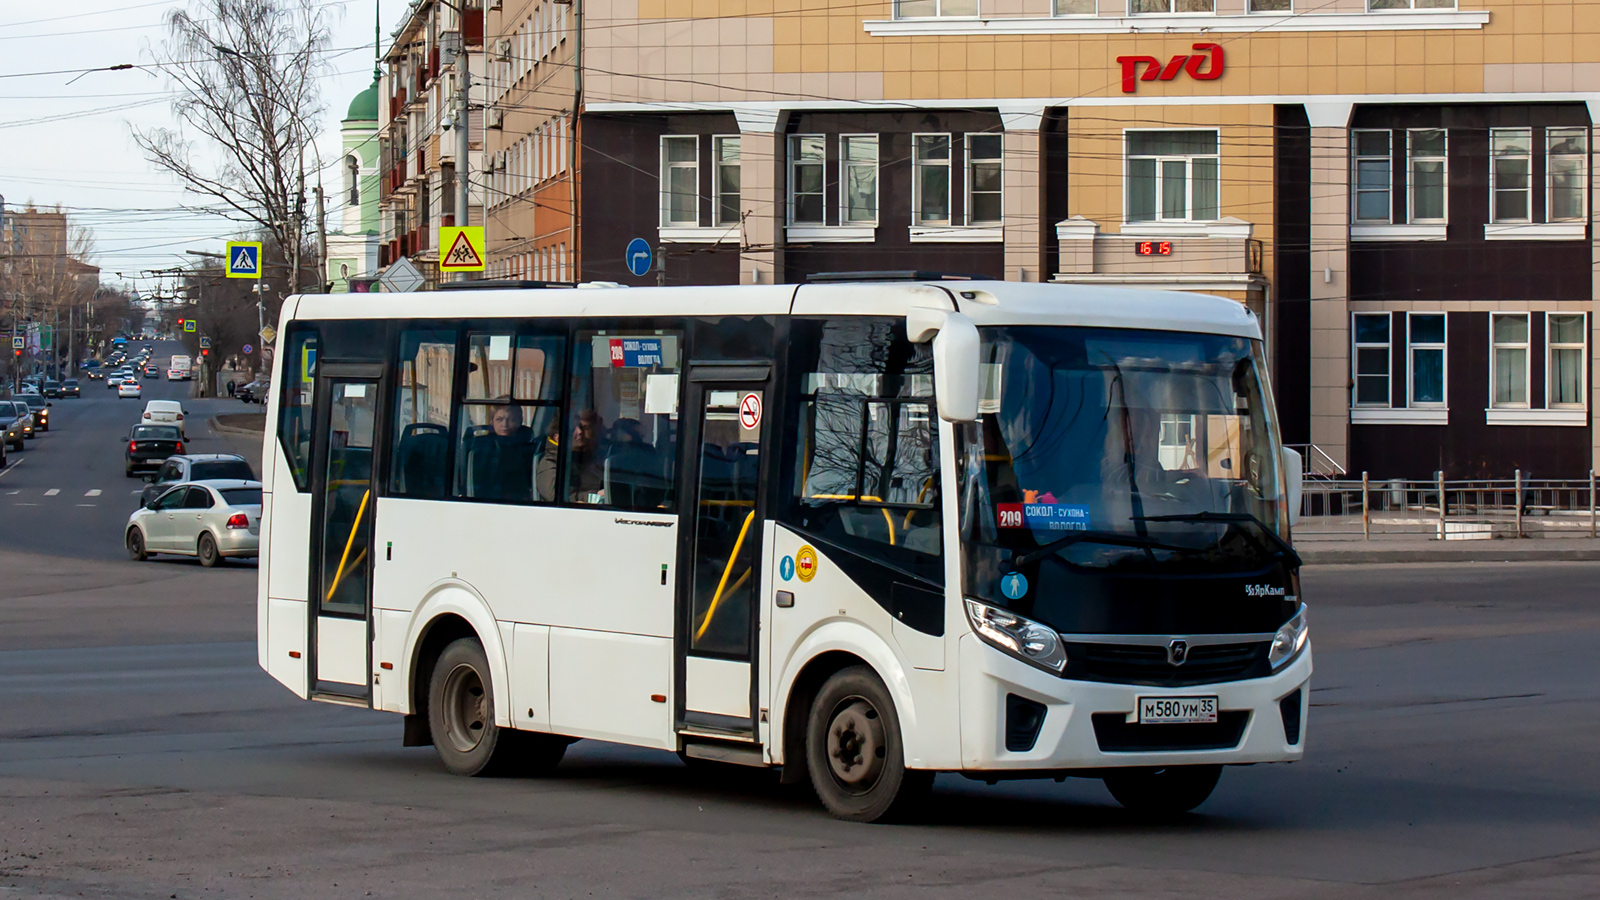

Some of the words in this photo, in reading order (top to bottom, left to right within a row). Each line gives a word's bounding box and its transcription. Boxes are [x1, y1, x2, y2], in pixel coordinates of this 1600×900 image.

[1140, 241, 1152, 255] 16
[1158, 241, 1171, 255] 15
[611, 345, 623, 360] 209
[1000, 510, 1022, 527] 209
[1025, 505, 1054, 517] СОКОЛ
[1058, 508, 1085, 518] СУХОНА
[1254, 584, 1285, 598] ЯрКамп
[1200, 699, 1213, 712] 35
